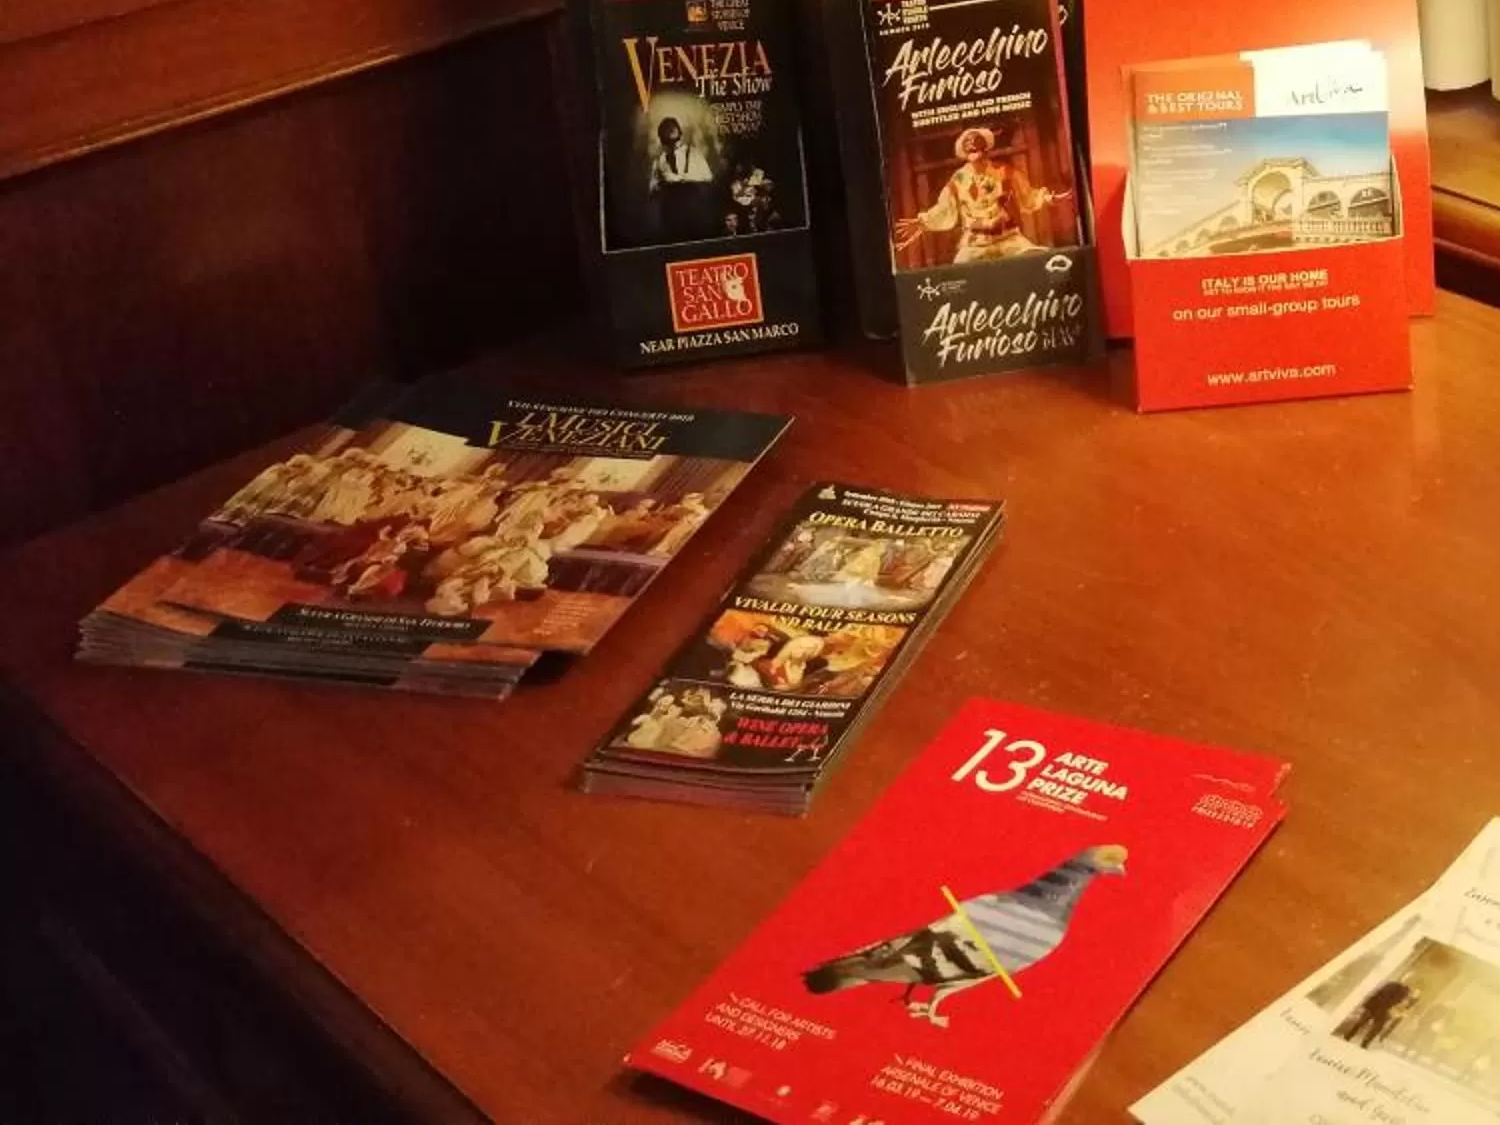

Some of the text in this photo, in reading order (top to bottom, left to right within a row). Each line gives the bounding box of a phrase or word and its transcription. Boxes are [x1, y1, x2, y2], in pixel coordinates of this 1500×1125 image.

[882, 24, 1048, 87] Arlecchino
[622, 36, 772, 114] VENEZIA
[898, 65, 1003, 112] Furioso
[676, 262, 748, 287] TEATRO
[1201, 277, 1239, 290] ITALY
[1259, 272, 1287, 284] OUR
[1290, 269, 1328, 281] HOME
[683, 284, 722, 304] SAN
[1173, 293, 1360, 321] on our small-group tours
[681, 299, 752, 323] GALLO
[640, 323, 799, 355] NEAR PIAZZA SAN MARCO
[937, 328, 1039, 368] Furioso
[1207, 362, 1336, 386] www.artviva.com
[809, 510, 964, 538] OPERA BALLETTO
[734, 596, 917, 624] VIVALDI FOUR SEASONS
[770, 614, 800, 627] AND
[952, 729, 1047, 792] 13
[1053, 752, 1109, 776] ARTE
[1027, 778, 1088, 805] PRIZE
[1040, 764, 1128, 801] LAGUNA
